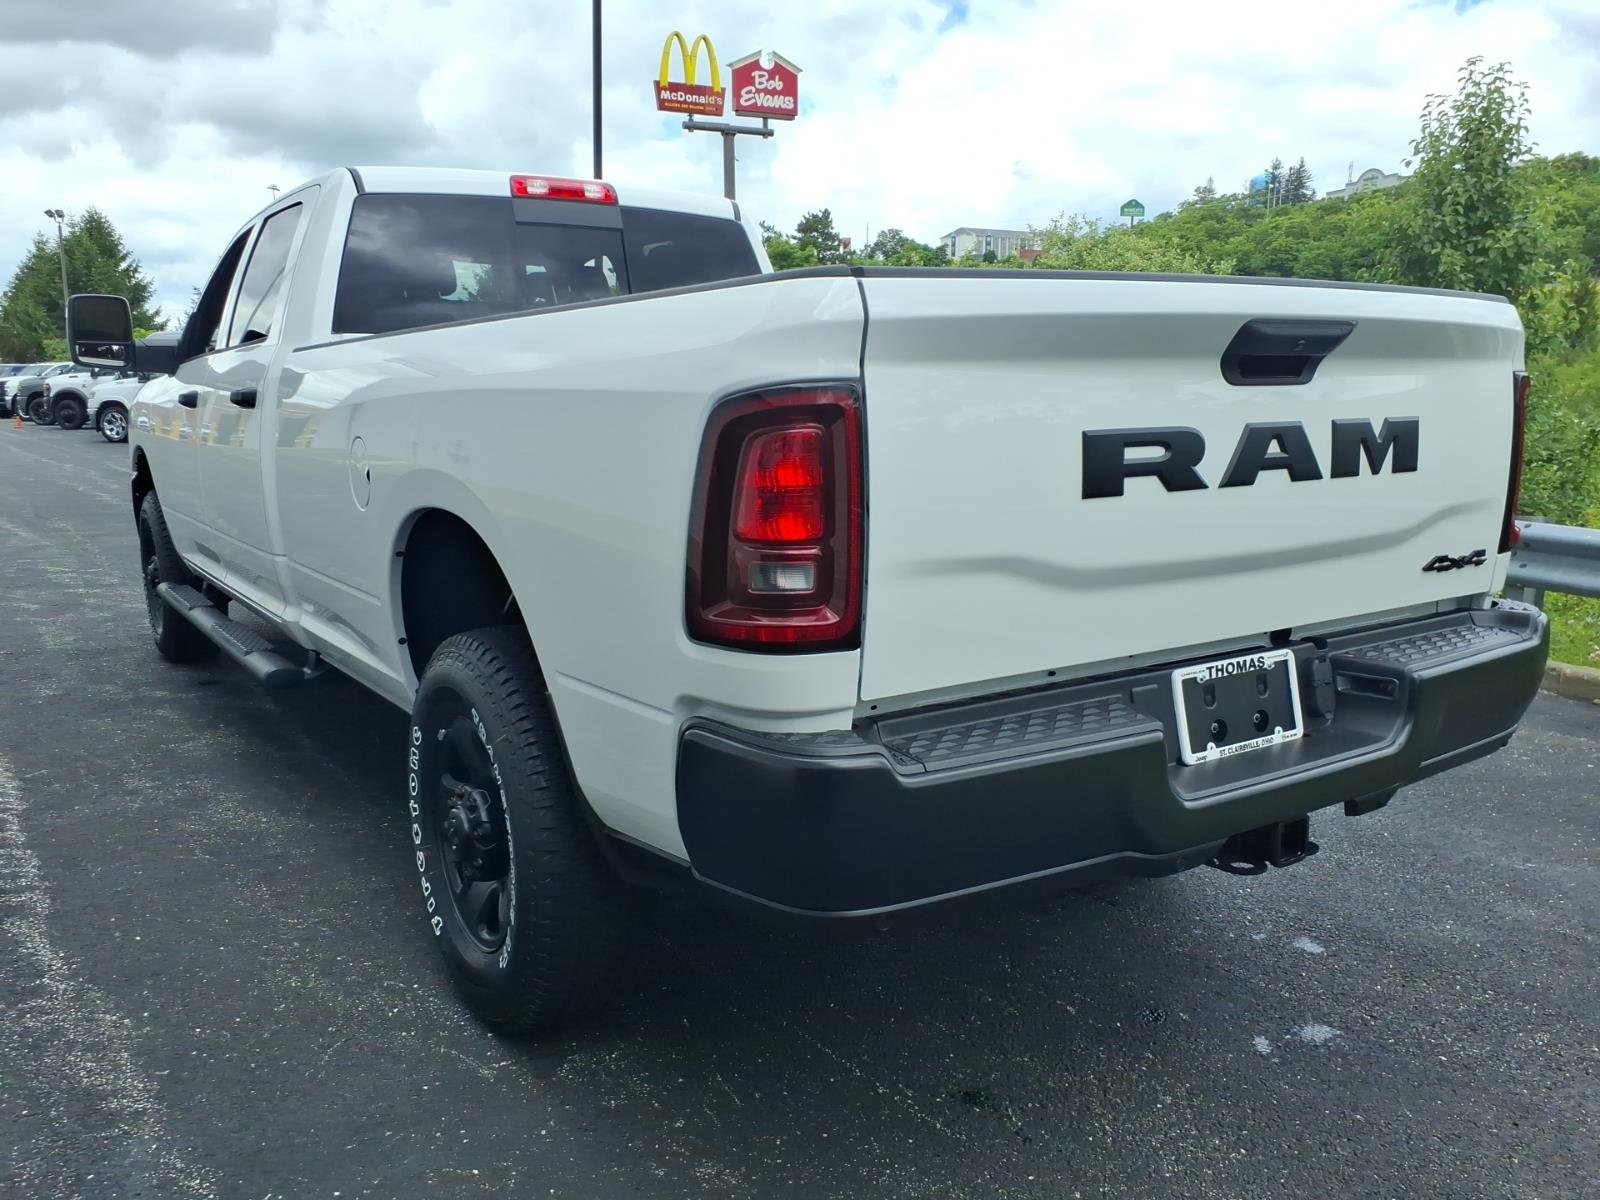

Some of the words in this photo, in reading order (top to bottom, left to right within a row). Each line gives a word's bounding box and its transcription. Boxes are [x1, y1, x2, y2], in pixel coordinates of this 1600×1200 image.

[752, 70, 783, 91] Bob
[660, 90, 723, 105] McDonald's
[740, 86, 794, 109] Evans
[1081, 416, 1420, 500] RAM
[1206, 656, 1265, 679] THOMAS
